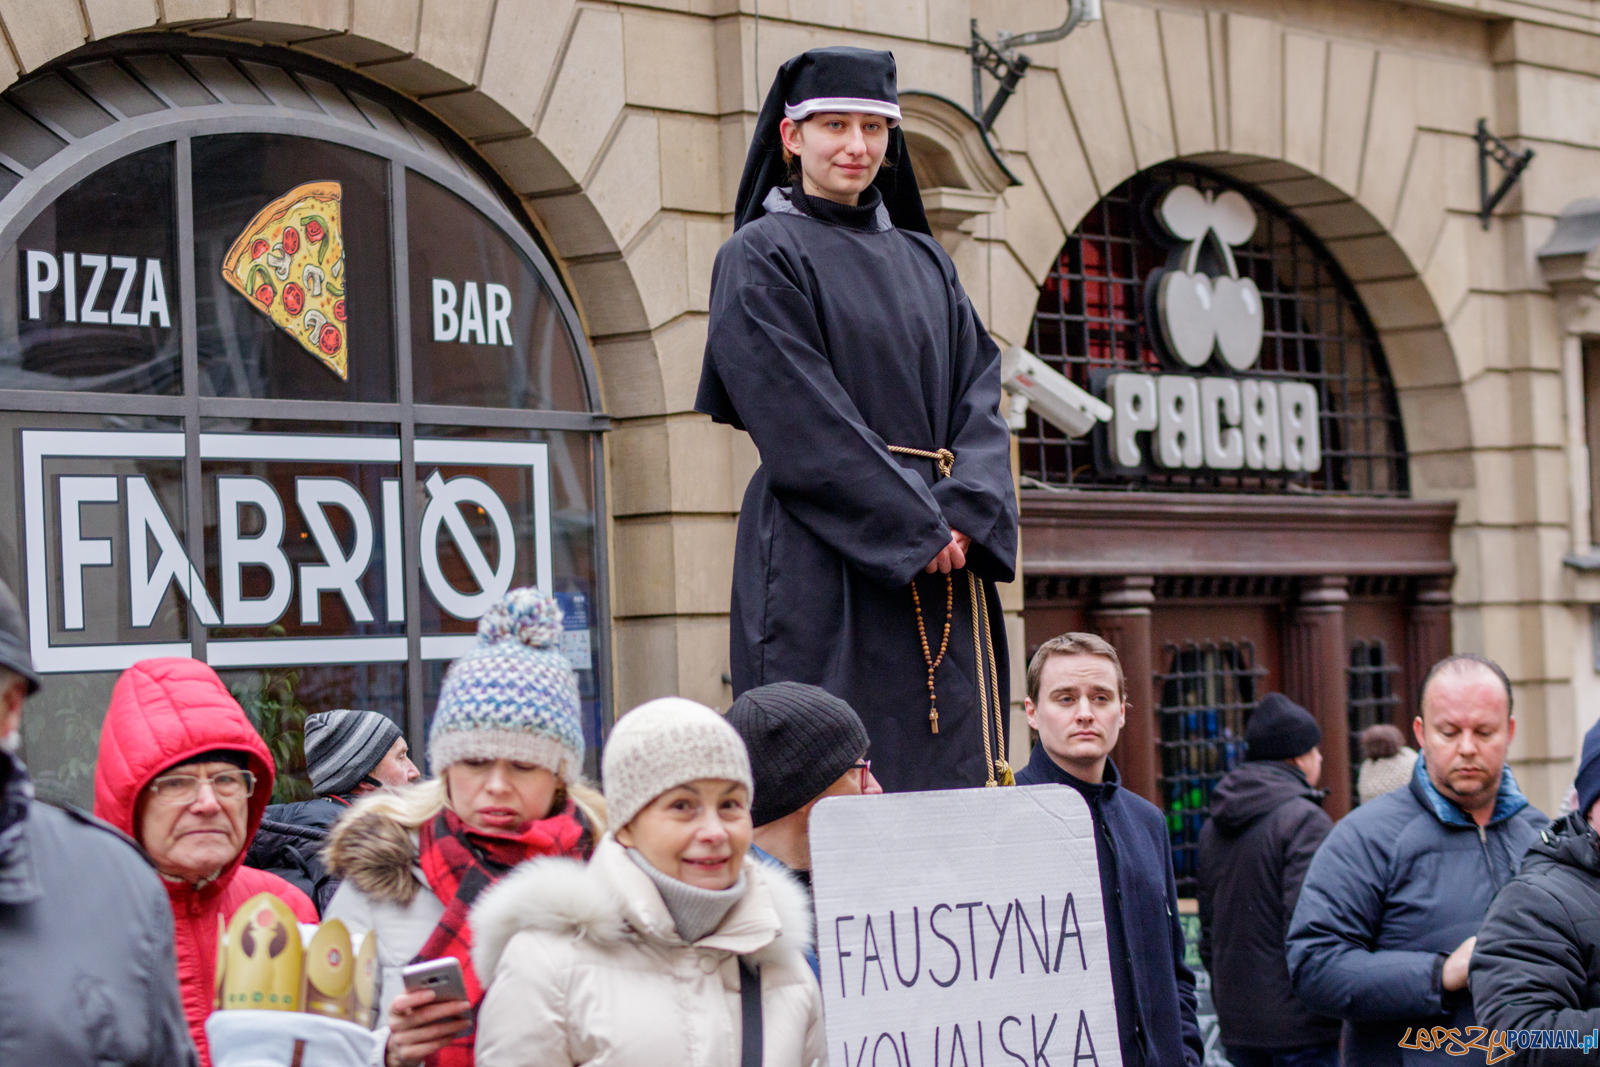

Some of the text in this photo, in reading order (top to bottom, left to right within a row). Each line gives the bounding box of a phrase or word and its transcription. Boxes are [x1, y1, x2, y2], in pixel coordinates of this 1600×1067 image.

[26, 250, 171, 327] PIZZA
[432, 278, 513, 346] BAR
[1107, 372, 1321, 473] PACHA
[836, 892, 1087, 998] FAUSTYNA
